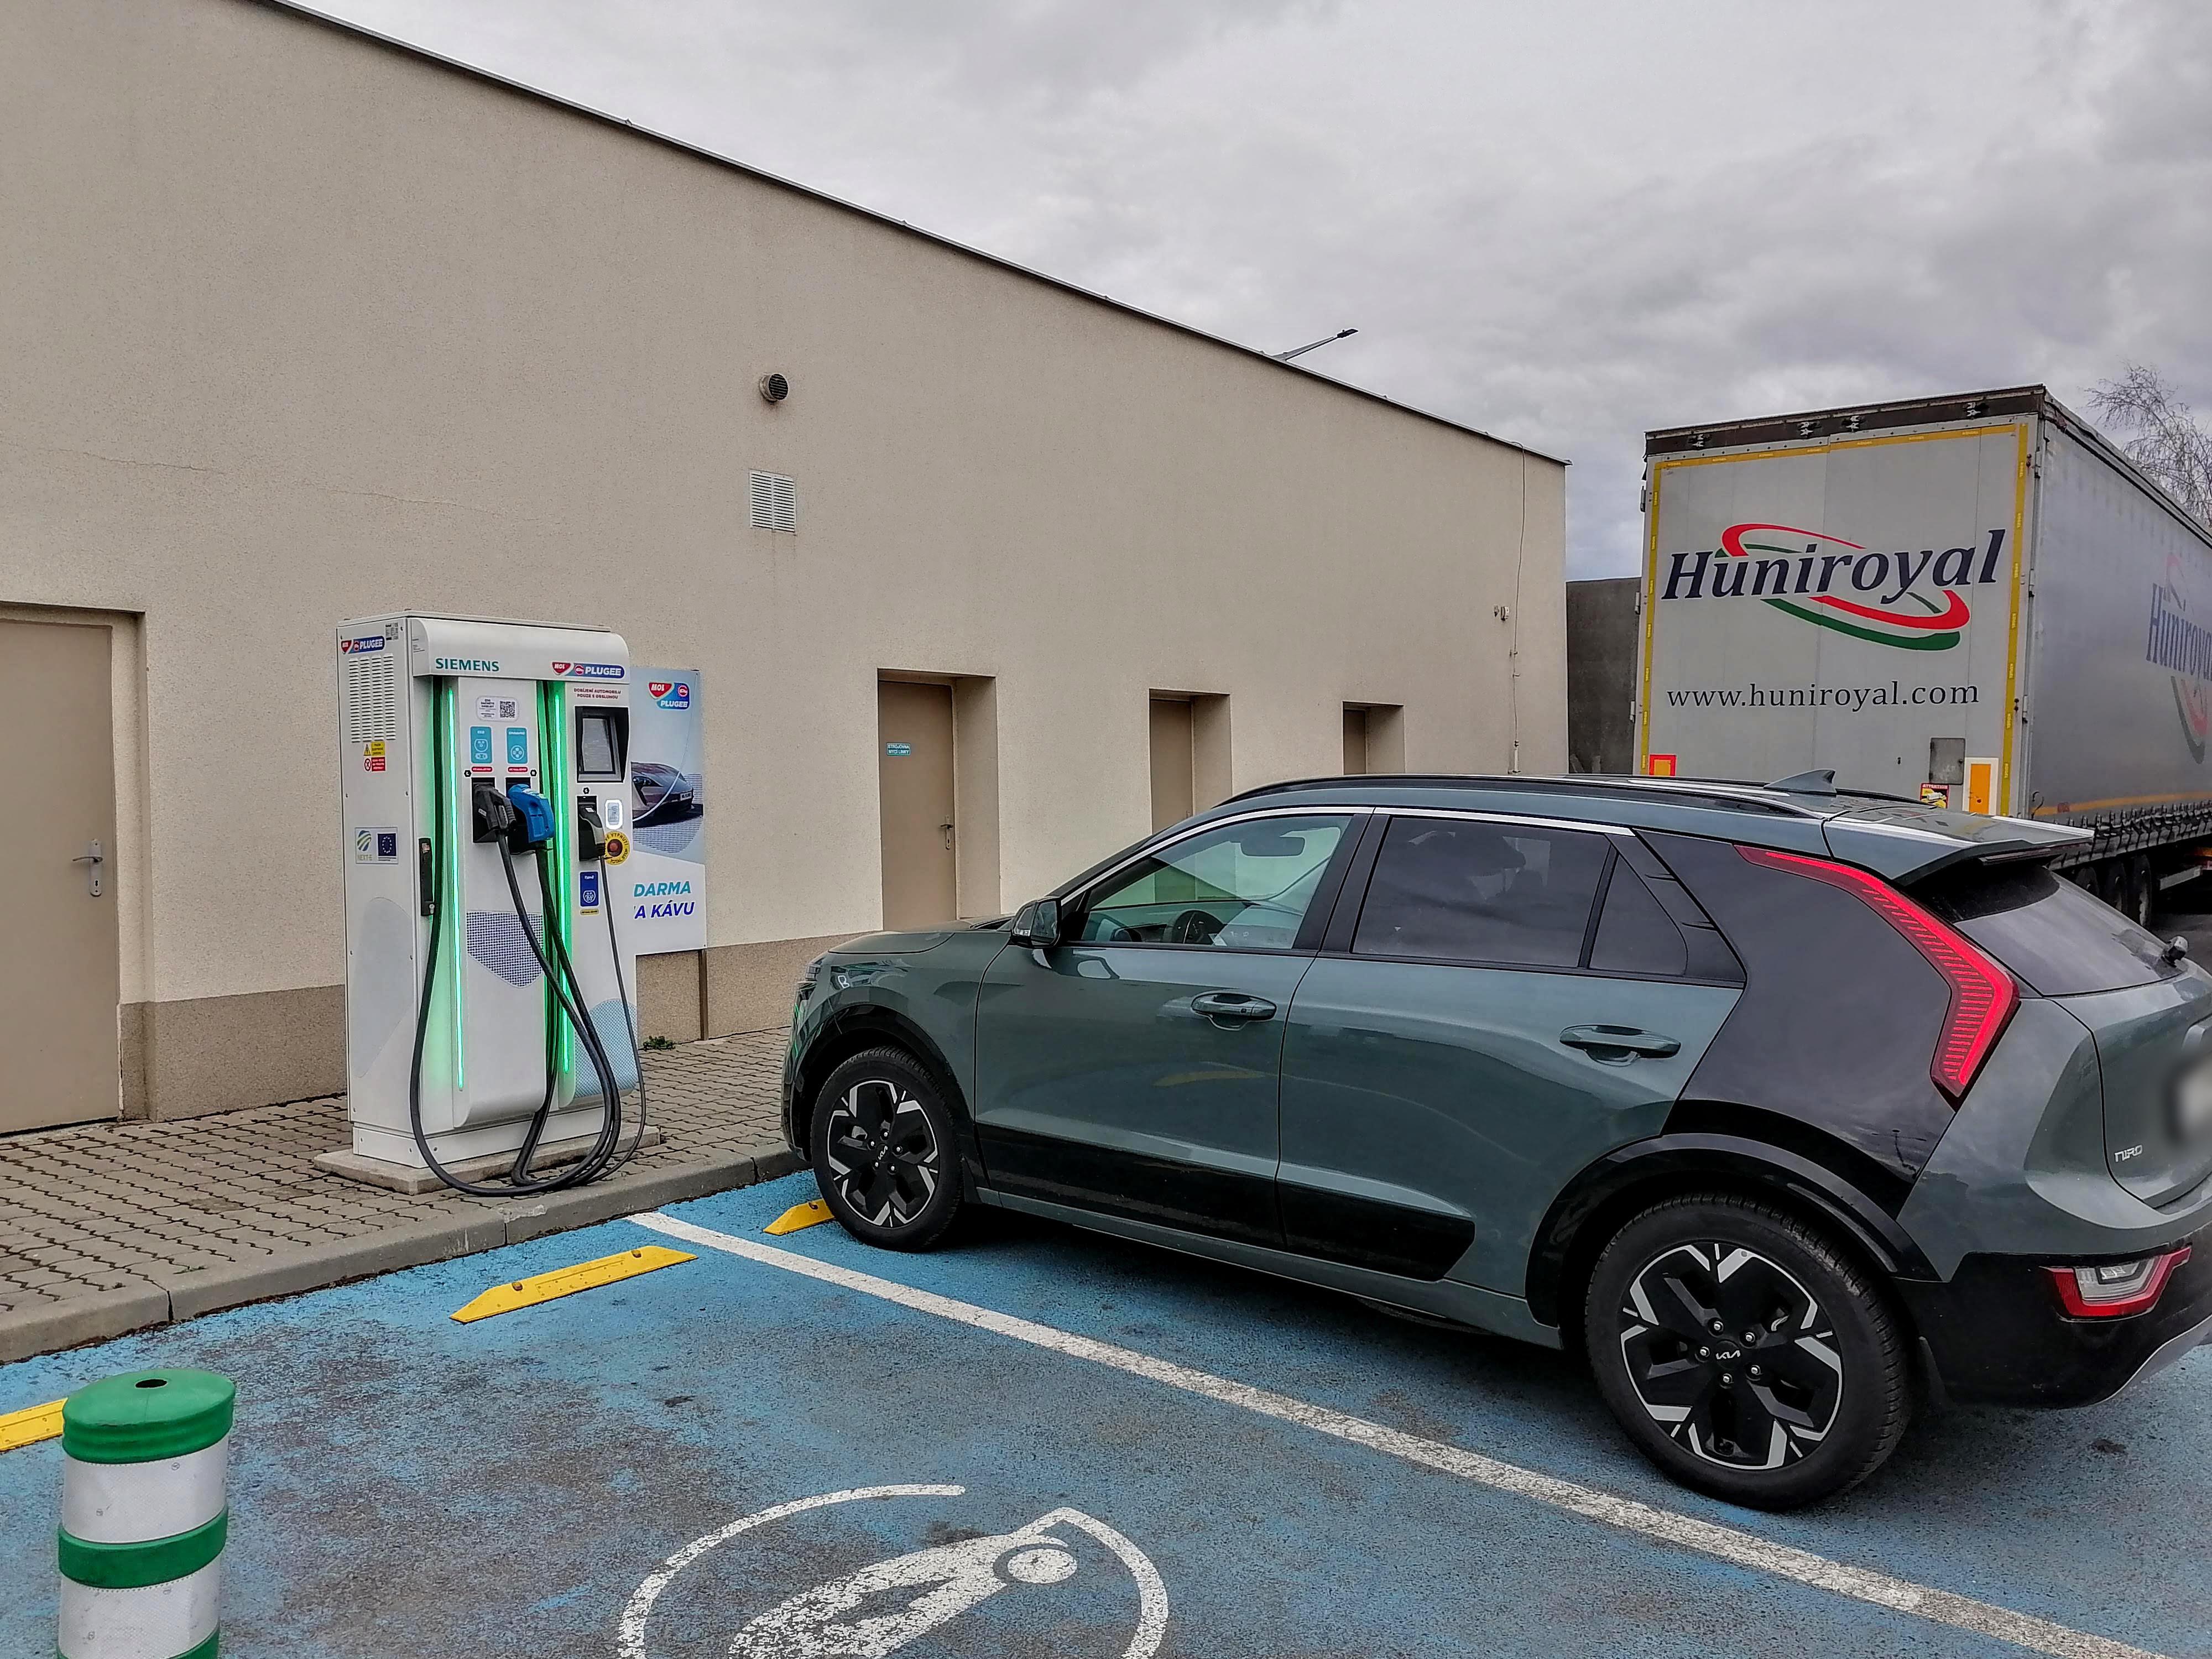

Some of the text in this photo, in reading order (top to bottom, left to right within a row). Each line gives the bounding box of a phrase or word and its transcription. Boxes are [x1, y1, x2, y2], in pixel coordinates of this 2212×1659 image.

[1661, 529, 2006, 604] Huniroyal
[360, 638, 383, 650] PLUGEE
[2146, 583, 2212, 697] Huniroya
[435, 658, 500, 672] SIEMENS
[585, 666, 622, 676] PLUGEE
[1666, 680, 1980, 712] www.huniroyal.com
[634, 900, 695, 919] A KÁVU
[1716, 1350, 1741, 1359] KIA
